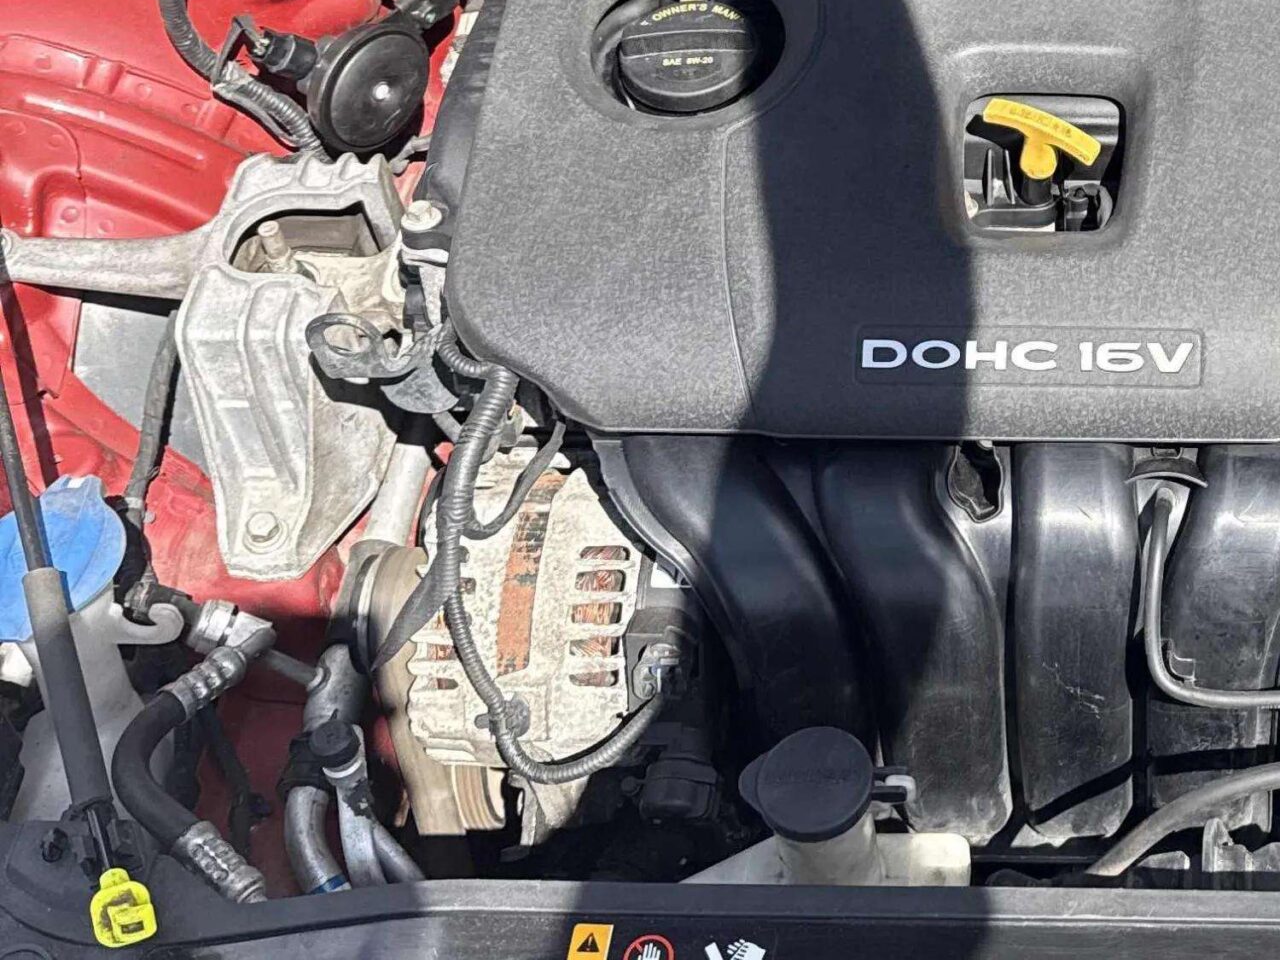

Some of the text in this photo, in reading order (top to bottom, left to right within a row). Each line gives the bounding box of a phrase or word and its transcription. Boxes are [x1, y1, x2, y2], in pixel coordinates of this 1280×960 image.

[652, 3, 708, 21] OWNER'S
[662, 58, 682, 66] SAE
[862, 338, 1194, 373] DOHC 16V
